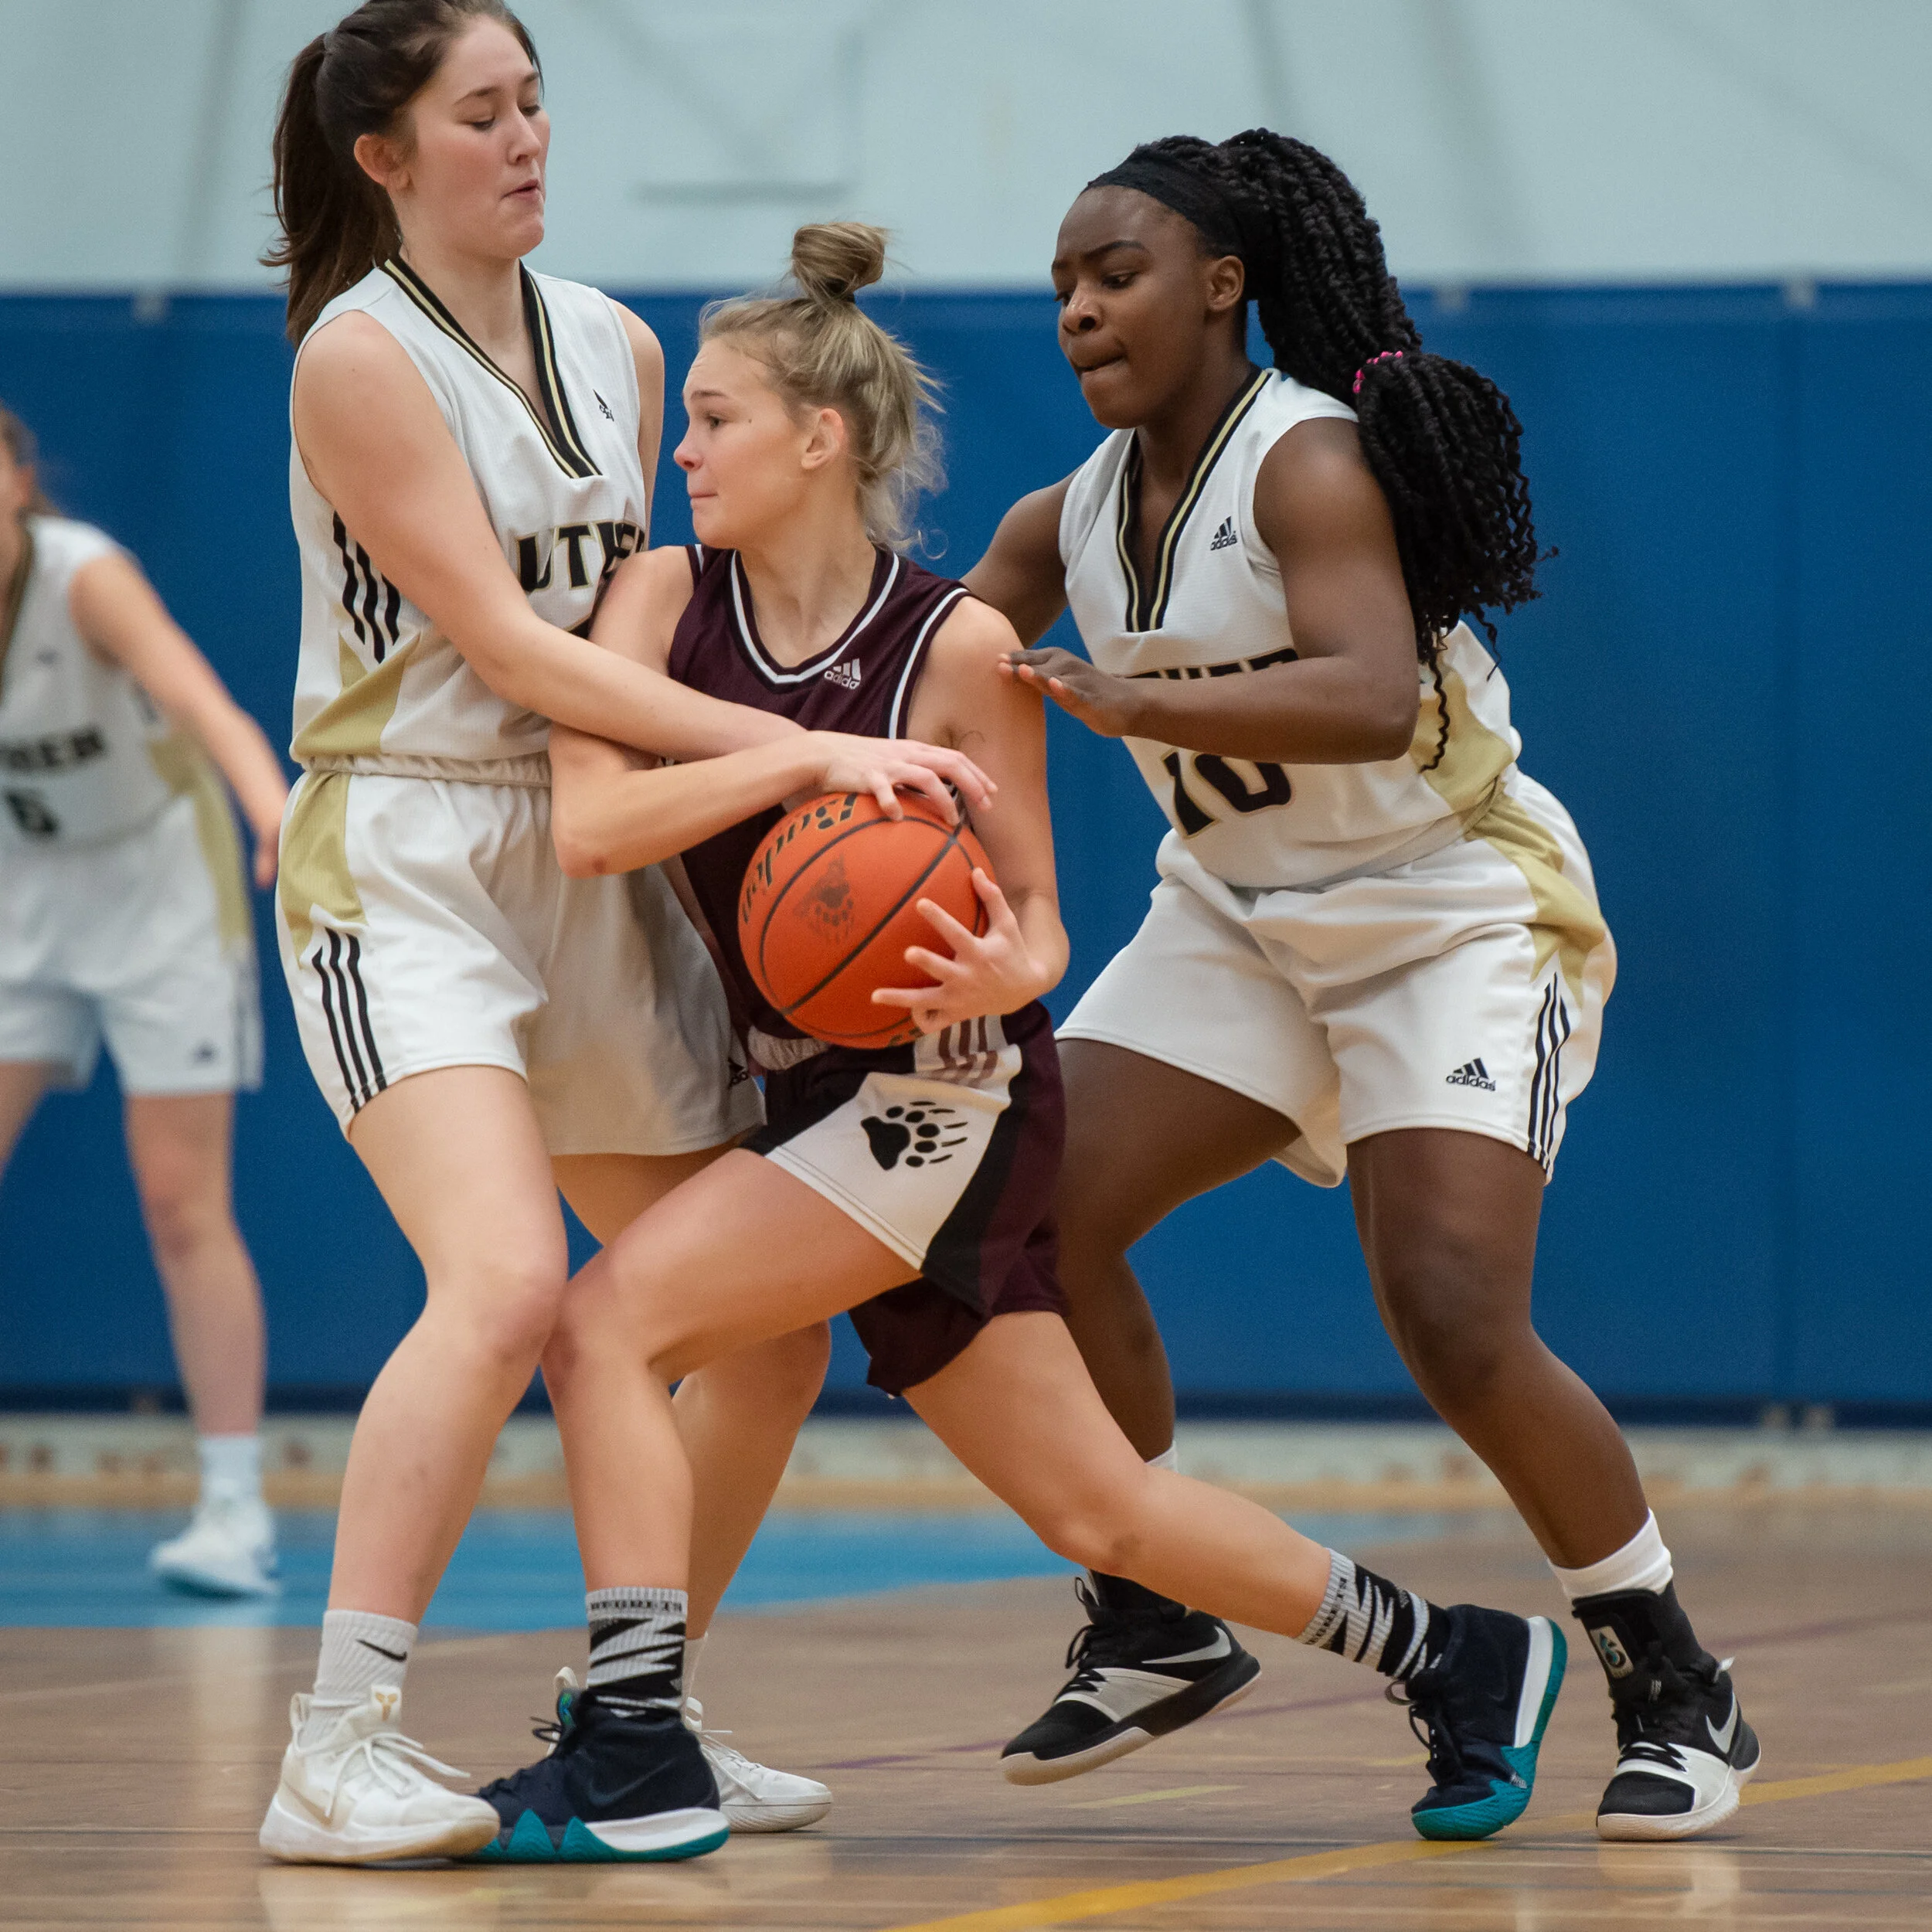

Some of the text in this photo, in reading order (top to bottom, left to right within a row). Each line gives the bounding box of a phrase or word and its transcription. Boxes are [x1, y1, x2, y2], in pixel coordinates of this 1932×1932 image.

[824, 670, 861, 690] adida
[1161, 748, 1298, 839] 10
[1445, 1073, 1496, 1092] adidas
